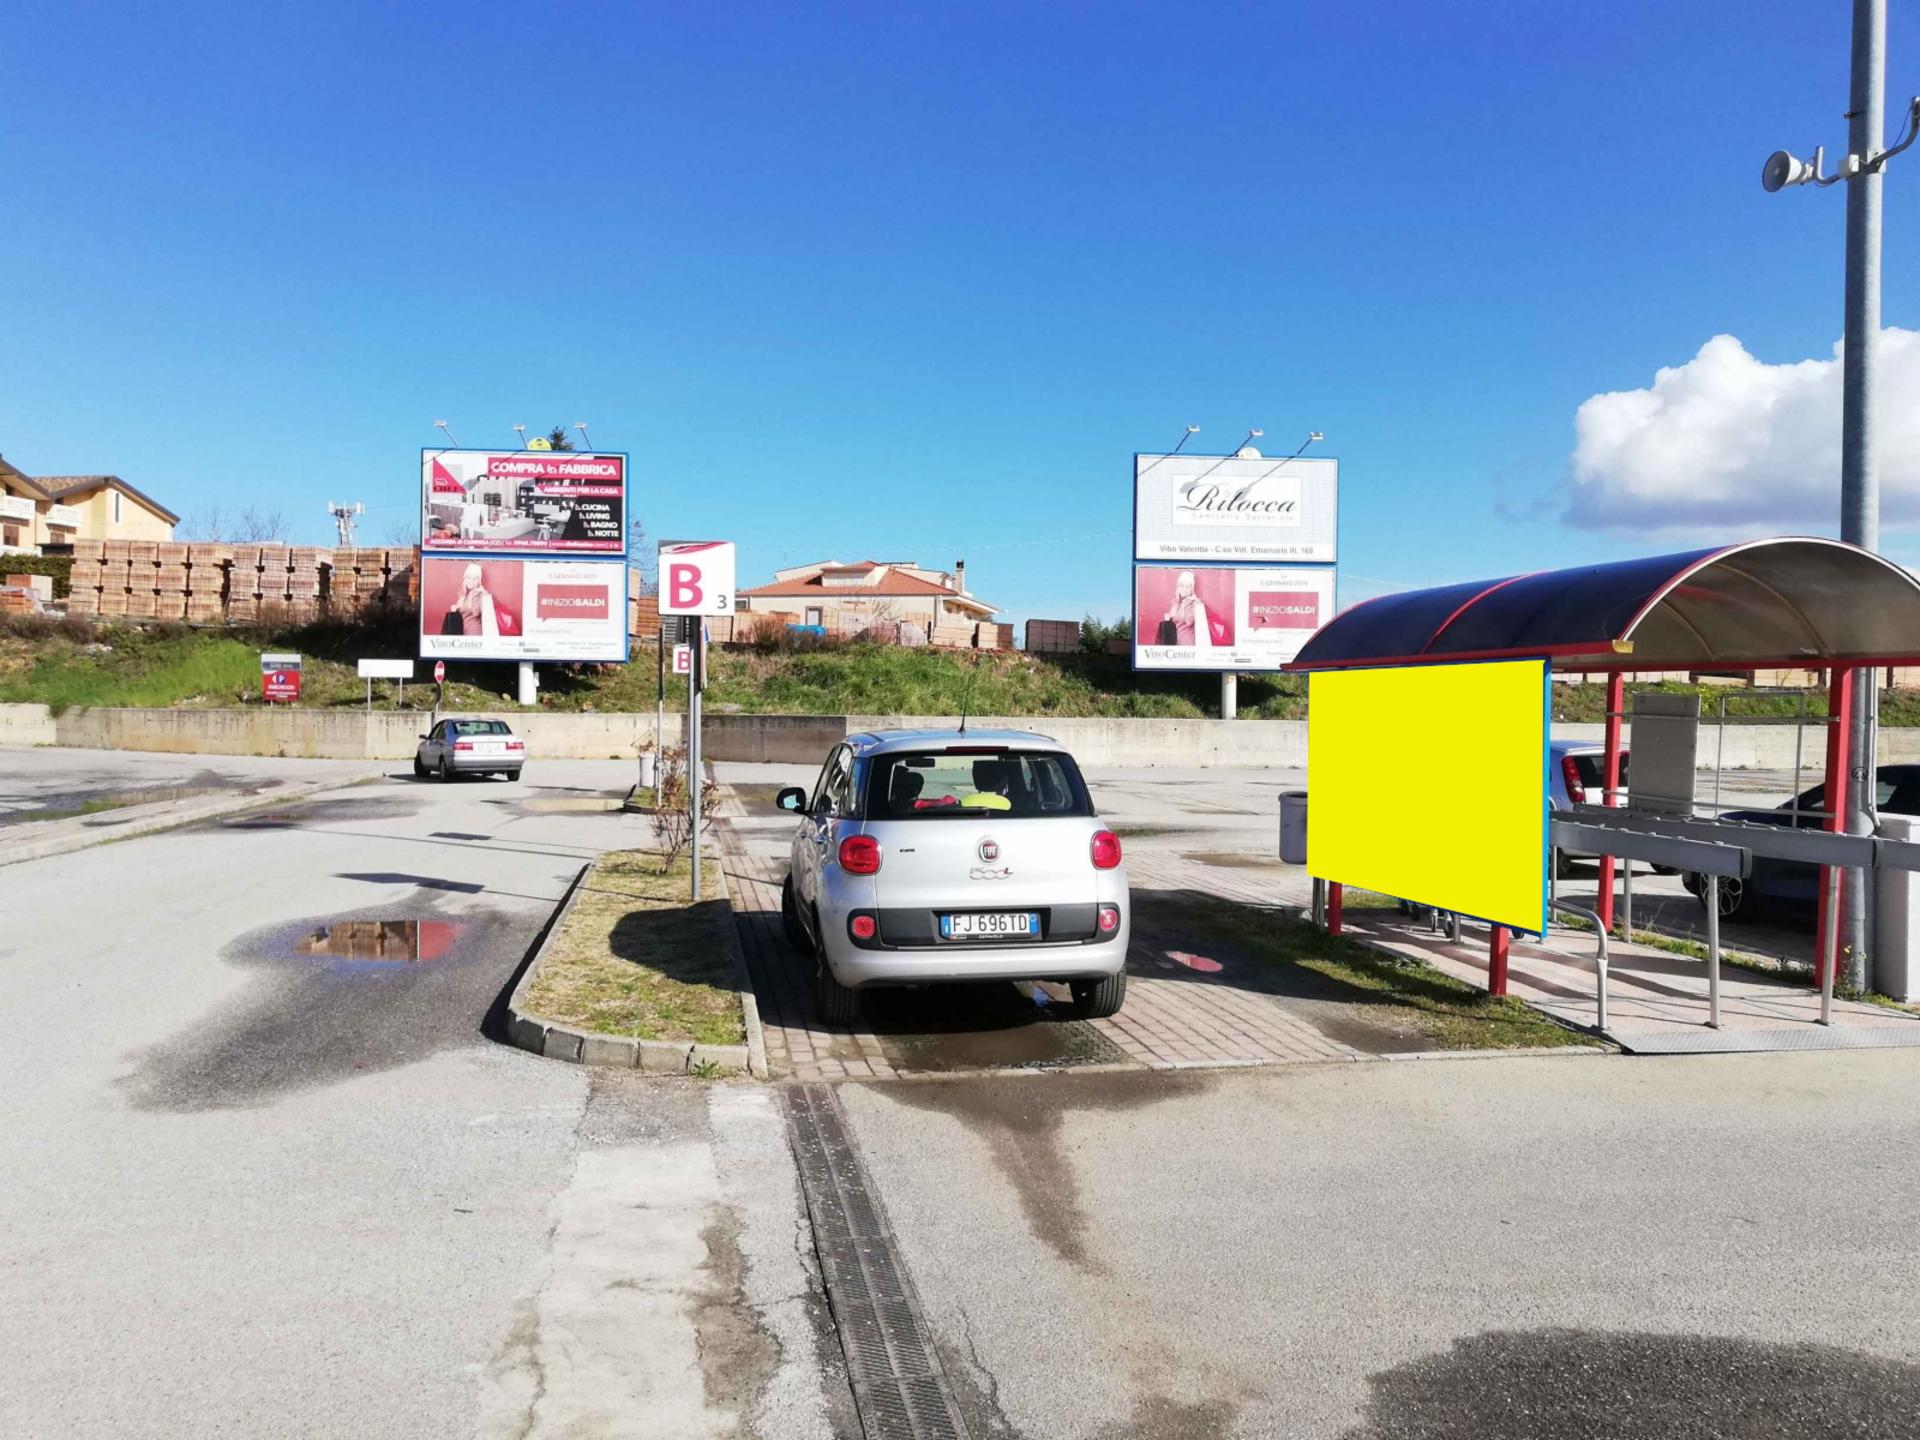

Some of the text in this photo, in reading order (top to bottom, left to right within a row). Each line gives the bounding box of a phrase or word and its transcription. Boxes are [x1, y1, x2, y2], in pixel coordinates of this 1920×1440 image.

[490, 461, 544, 474] COMPRA
[558, 463, 616, 476] FABBRICA
[1176, 482, 1296, 513] Rilocca
[581, 503, 610, 511] CUCINA
[586, 512, 611, 520] LIVING
[590, 521, 618, 529] BAGNO
[1159, 544, 1177, 553] Vibo
[1178, 544, 1208, 554] Valentia
[1215, 545, 1232, 554] C.so
[1250, 546, 1288, 555] Emanuele
[669, 563, 728, 610] B 3
[541, 598, 606, 607] #INIZIOSALDI
[677, 651, 690, 671] B
[953, 915, 972, 932] FJ
[978, 914, 1027, 932] 696TD
